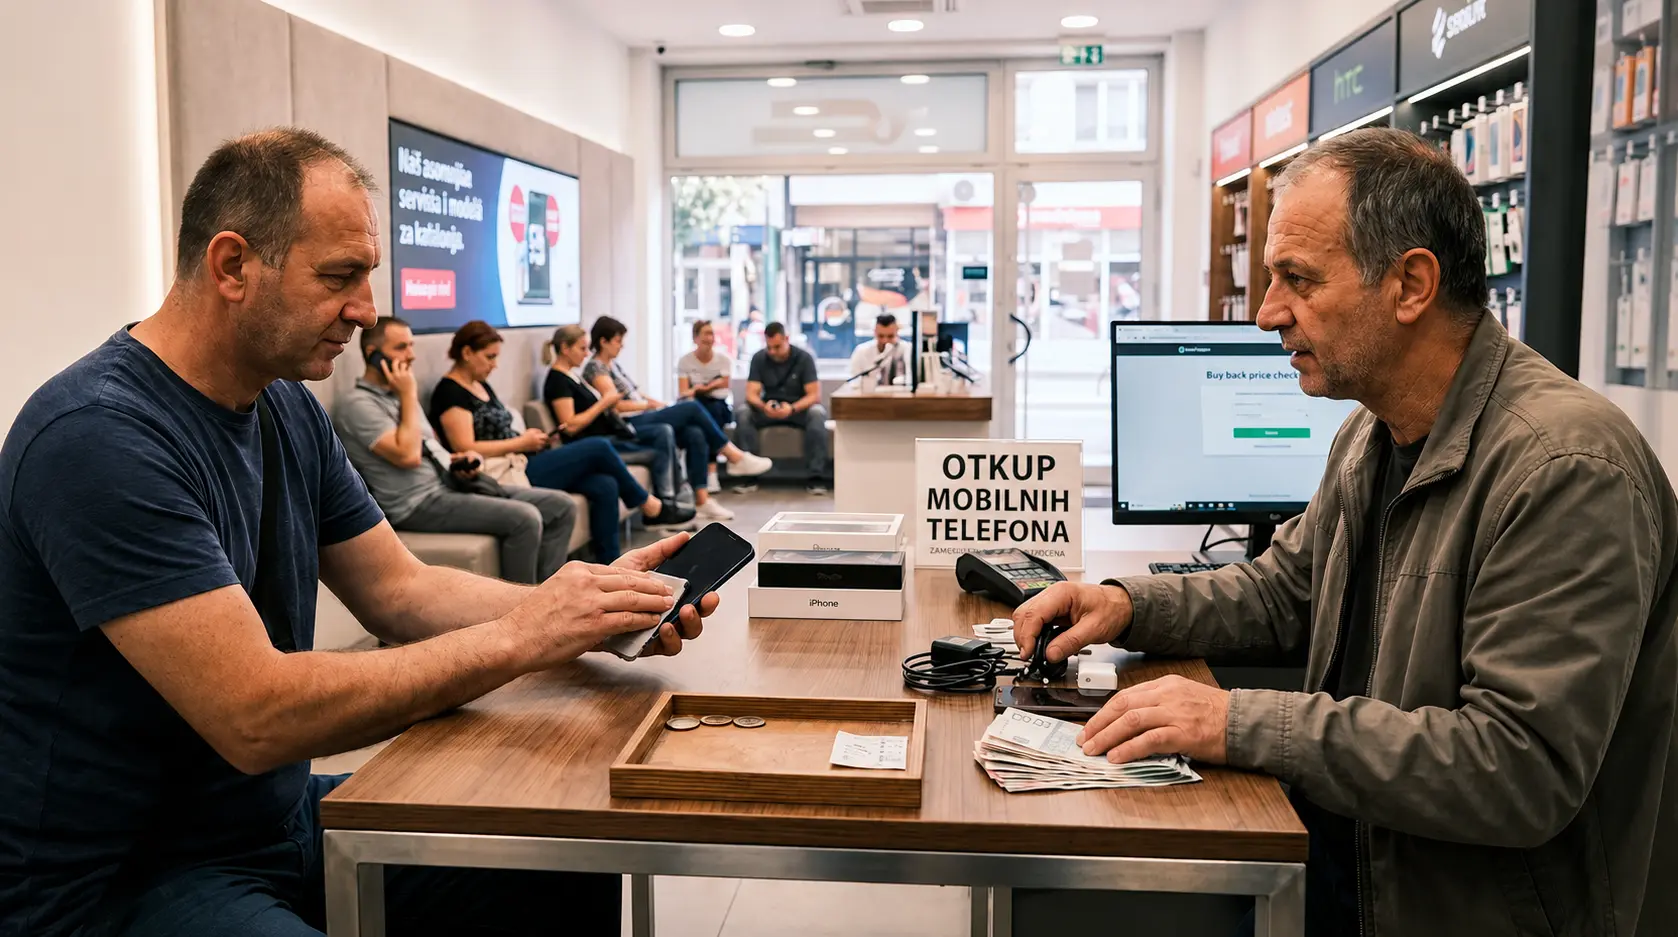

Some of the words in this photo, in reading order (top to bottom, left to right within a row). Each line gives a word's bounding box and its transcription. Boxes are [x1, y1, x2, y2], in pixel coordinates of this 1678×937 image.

[399, 224, 414, 246] za
[1206, 371, 1224, 381] Buy
[1225, 370, 1247, 380] back
[1248, 370, 1272, 382] price
[1273, 370, 1298, 380] check
[942, 453, 1056, 481] OTKUP
[927, 488, 1069, 512] MOBILNIH
[926, 518, 1070, 543] TELEFONA
[809, 598, 839, 608] iPhone
